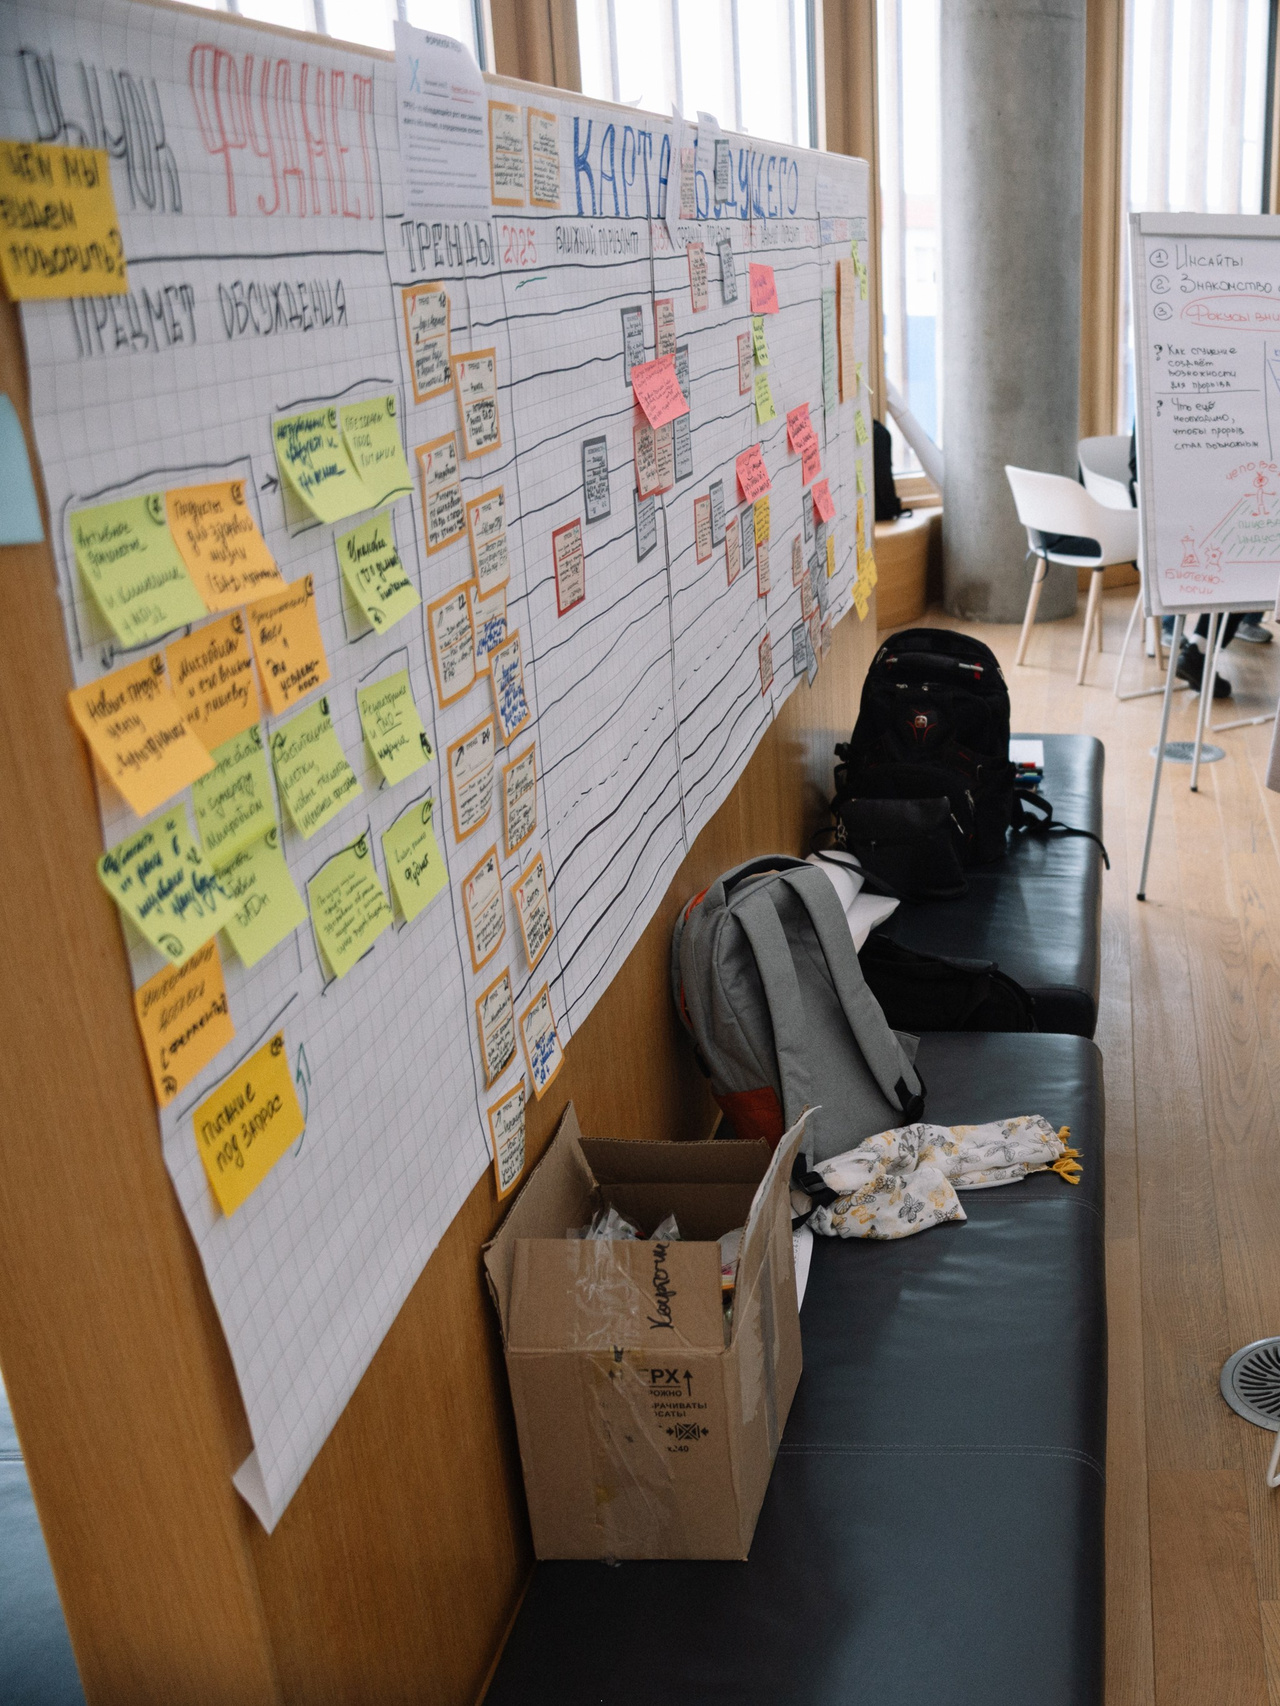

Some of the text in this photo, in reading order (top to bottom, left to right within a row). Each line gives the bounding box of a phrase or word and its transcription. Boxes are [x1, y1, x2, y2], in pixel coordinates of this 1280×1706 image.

[190, 43, 374, 220] ФУДНЕТ
[572, 116, 670, 217] КАРТА
[694, 134, 798, 224] БДУЩЕГО
[400, 220, 494, 272] ТРЕНДЫ
[502, 224, 538, 265] 2025
[217, 279, 348, 339] ОБСУЖДЕНИЯ
